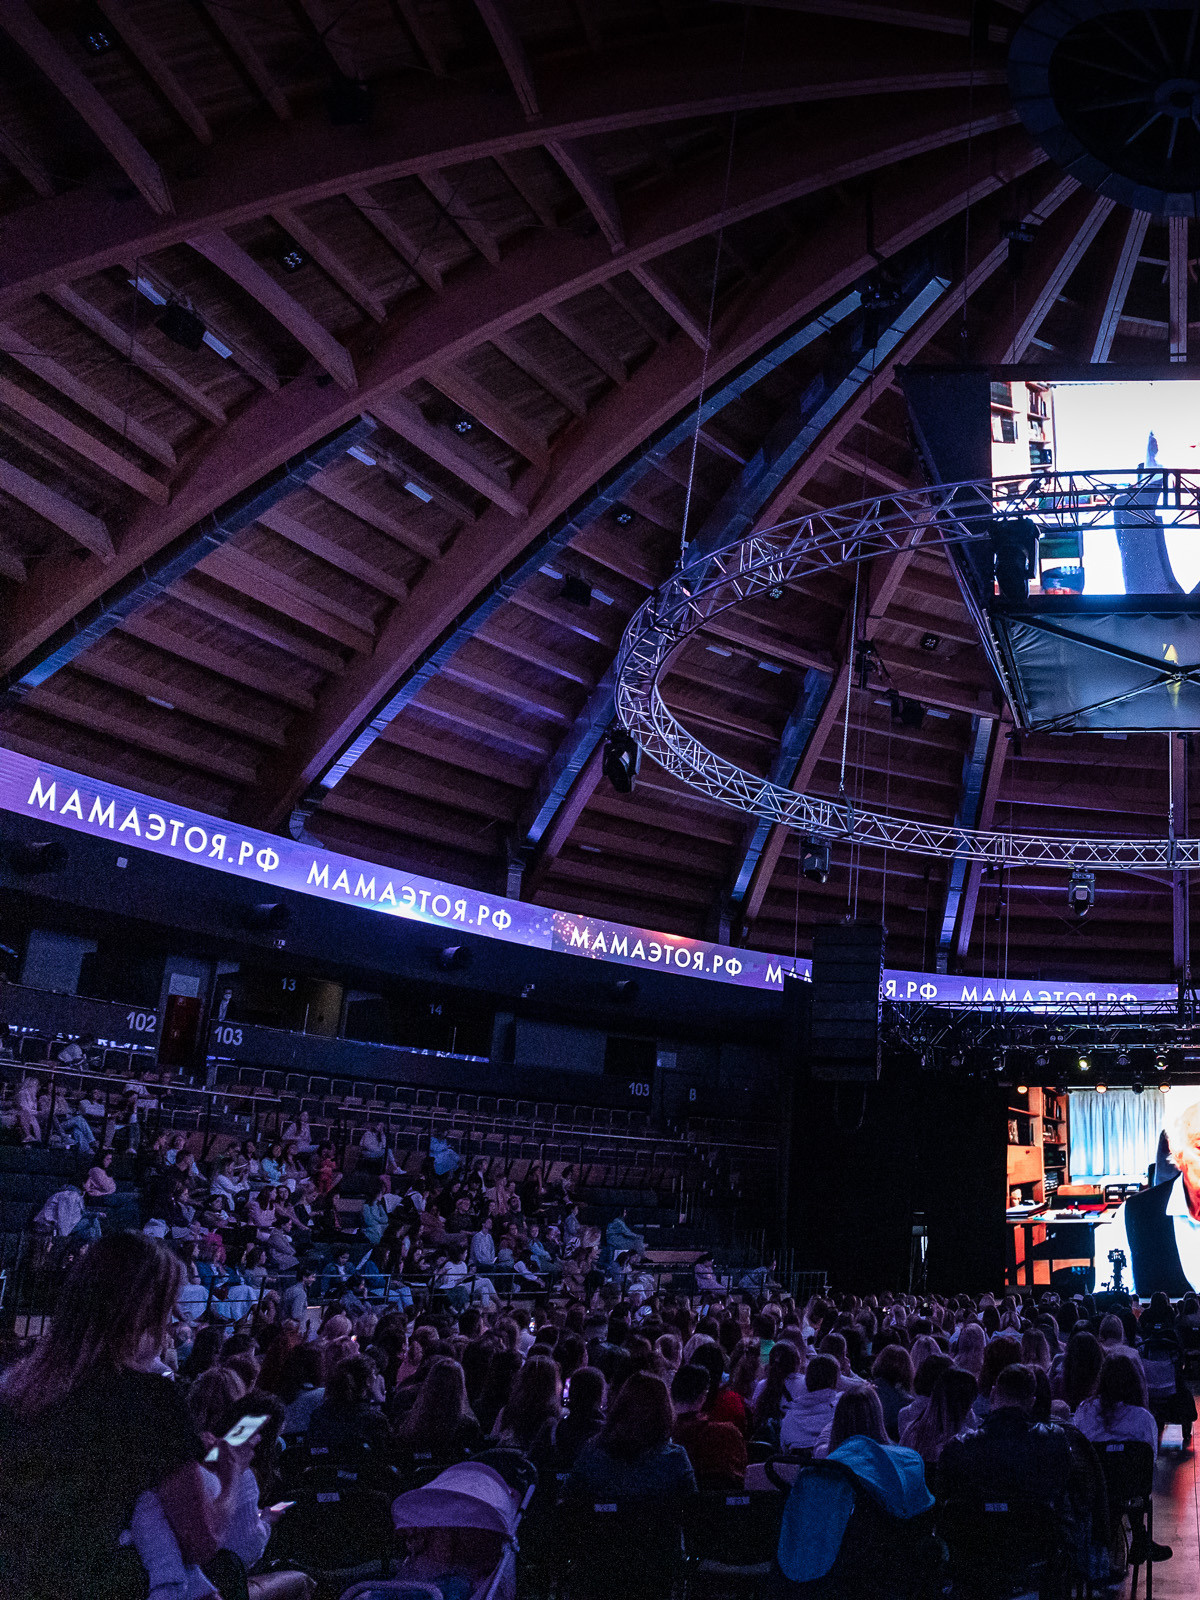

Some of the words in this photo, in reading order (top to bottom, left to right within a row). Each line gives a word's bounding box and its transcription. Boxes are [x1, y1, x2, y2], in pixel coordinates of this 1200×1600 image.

[27, 776, 280, 873] МАМАЭТОЯ.РФ
[306, 860, 512, 930] МАМАЭТОЯ.РФ
[570, 926, 742, 976] МАМАЭТОЯ.РФ
[281, 977, 297, 992] 13
[429, 1003, 443, 1015] 14
[126, 1011, 157, 1033] 102
[214, 1025, 243, 1046] 103
[628, 1082, 650, 1097] 103
